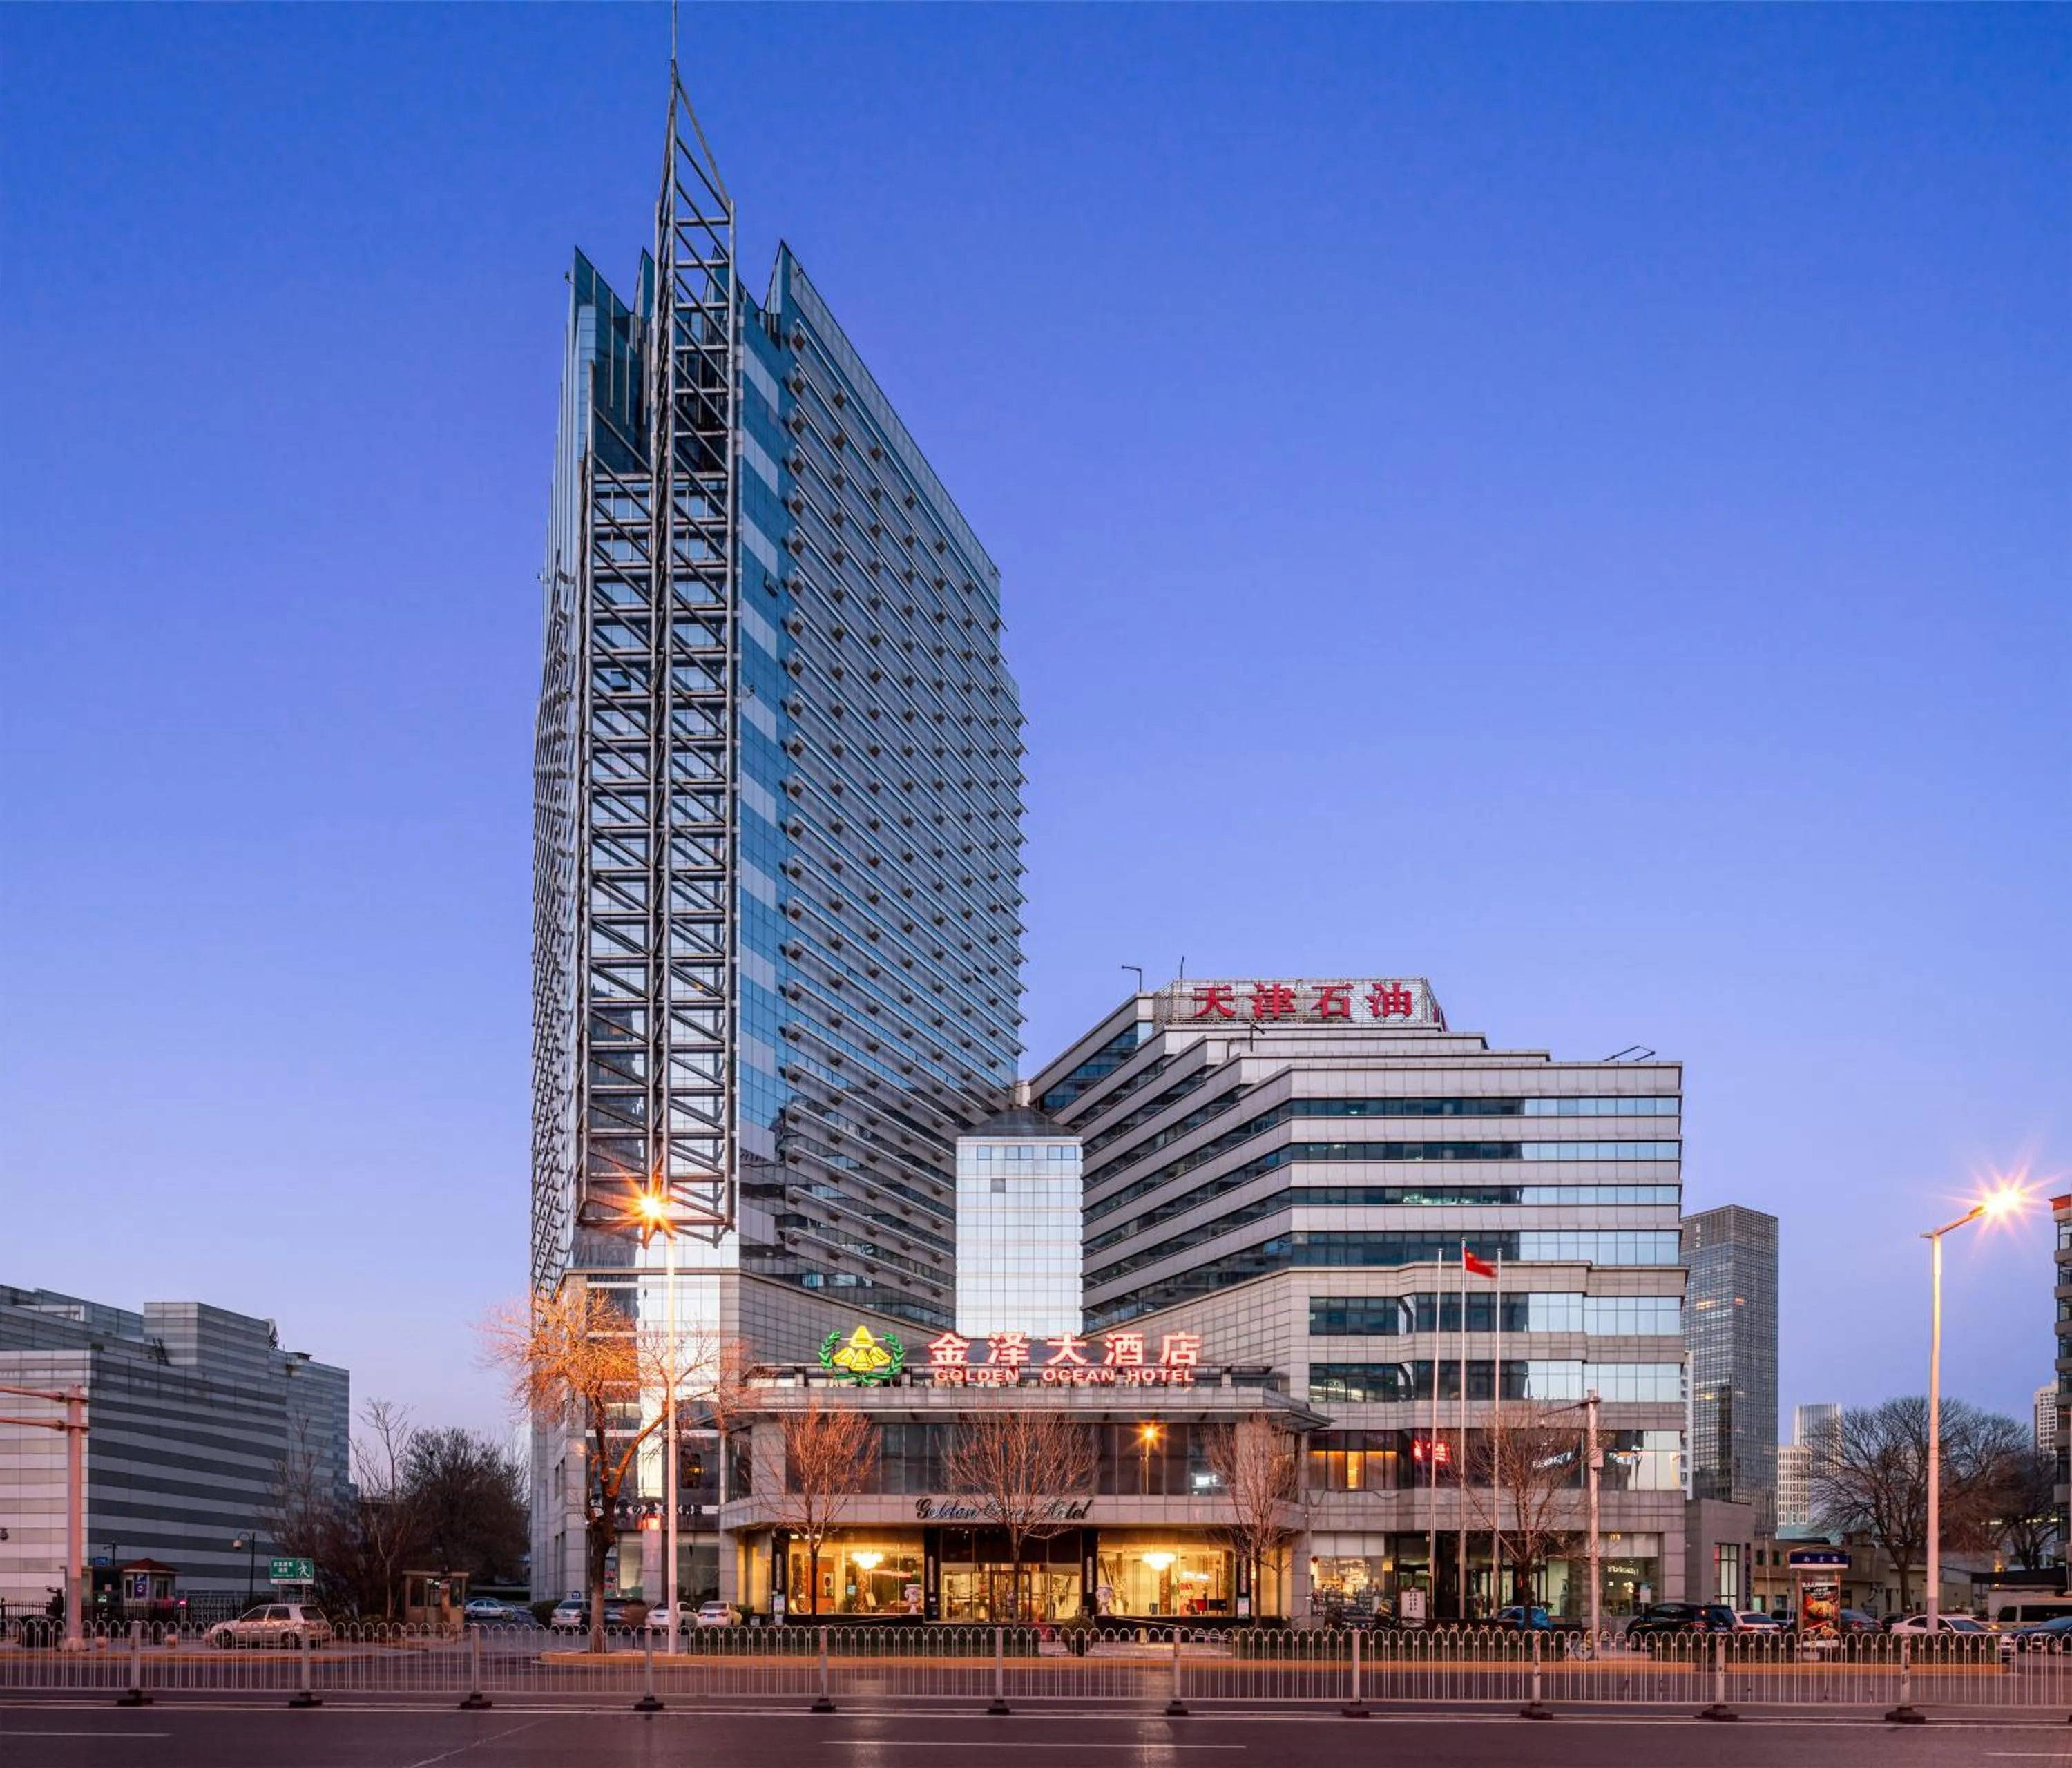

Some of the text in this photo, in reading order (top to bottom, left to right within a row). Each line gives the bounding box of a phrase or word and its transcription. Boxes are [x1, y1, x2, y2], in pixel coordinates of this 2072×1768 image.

[1193, 982, 1414, 1018] 天津石油
[928, 1331, 1201, 1367] 金泽大酒店
[934, 1369, 1195, 1382] GOLDEN OCEAN HOTEL
